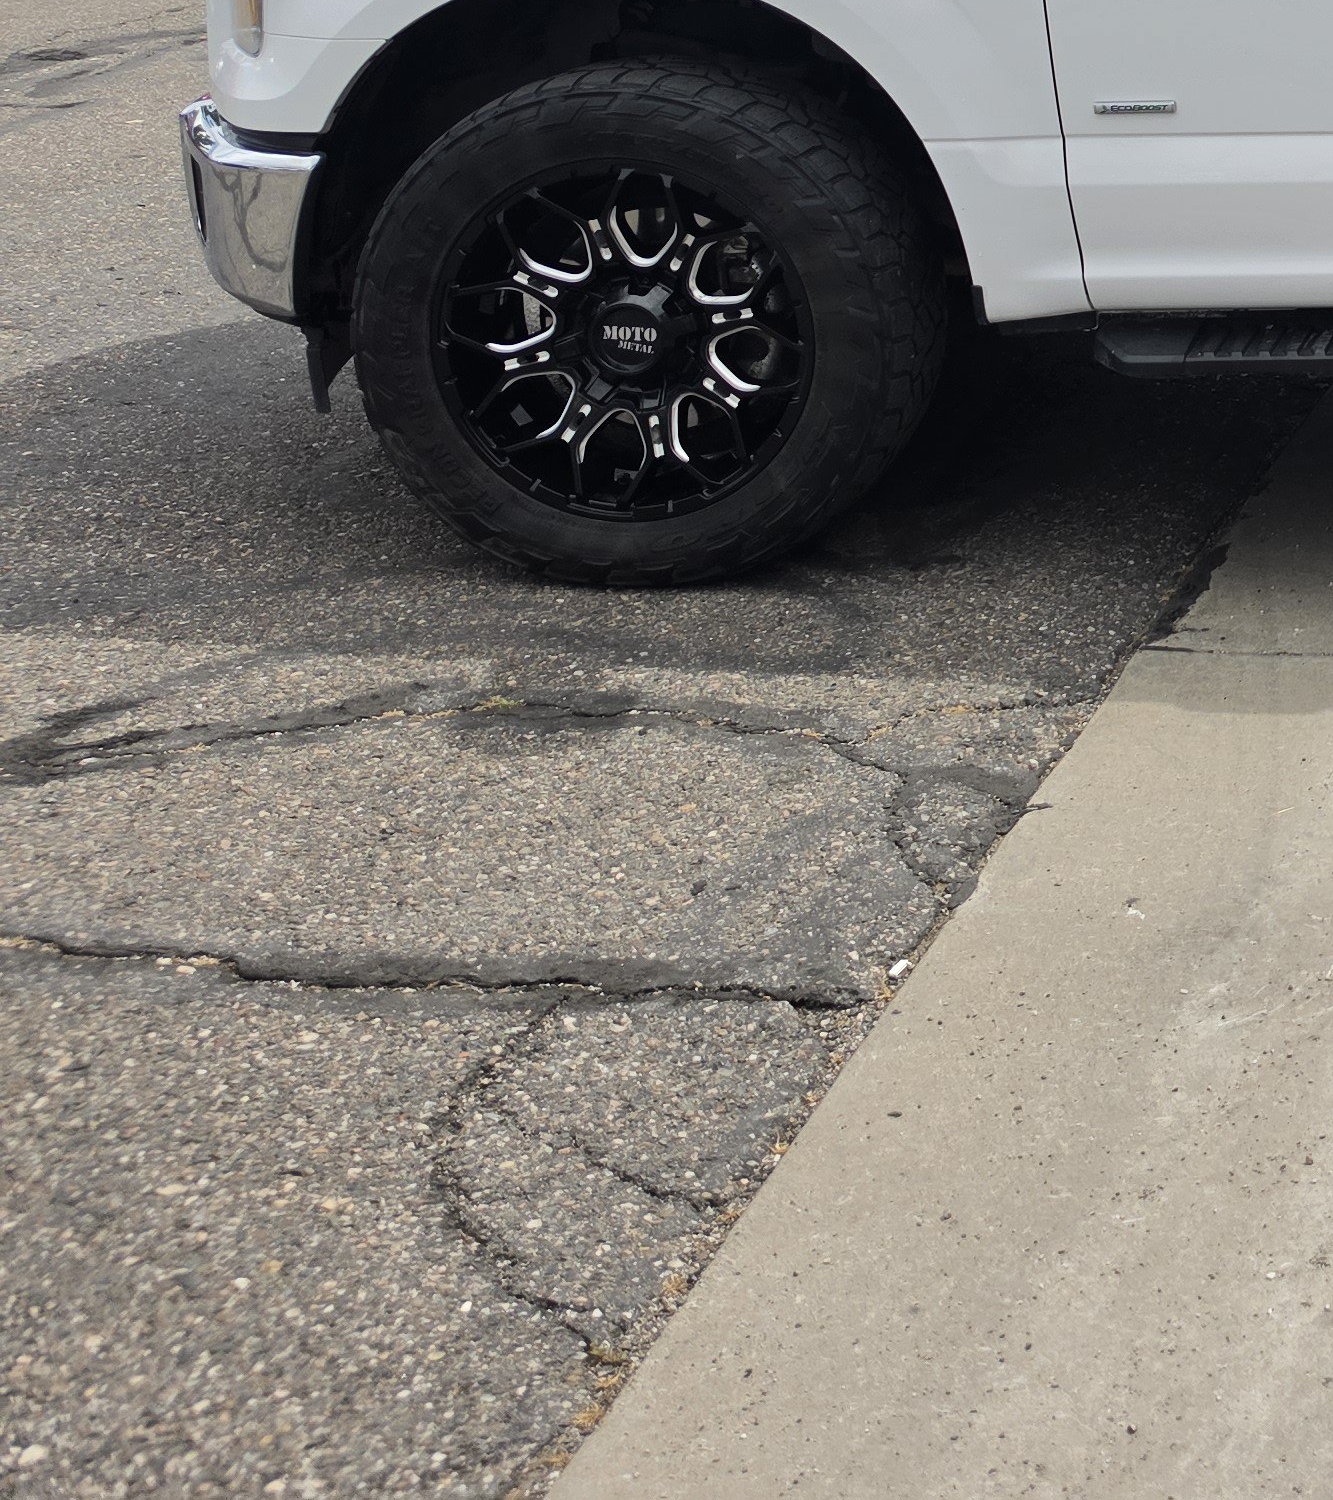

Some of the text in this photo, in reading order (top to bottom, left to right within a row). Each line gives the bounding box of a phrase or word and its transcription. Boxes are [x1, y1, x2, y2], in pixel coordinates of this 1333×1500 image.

[1110, 104, 1168, 112] ECOBOOST
[602, 325, 657, 342] MOTO
[617, 340, 655, 355] METAL
